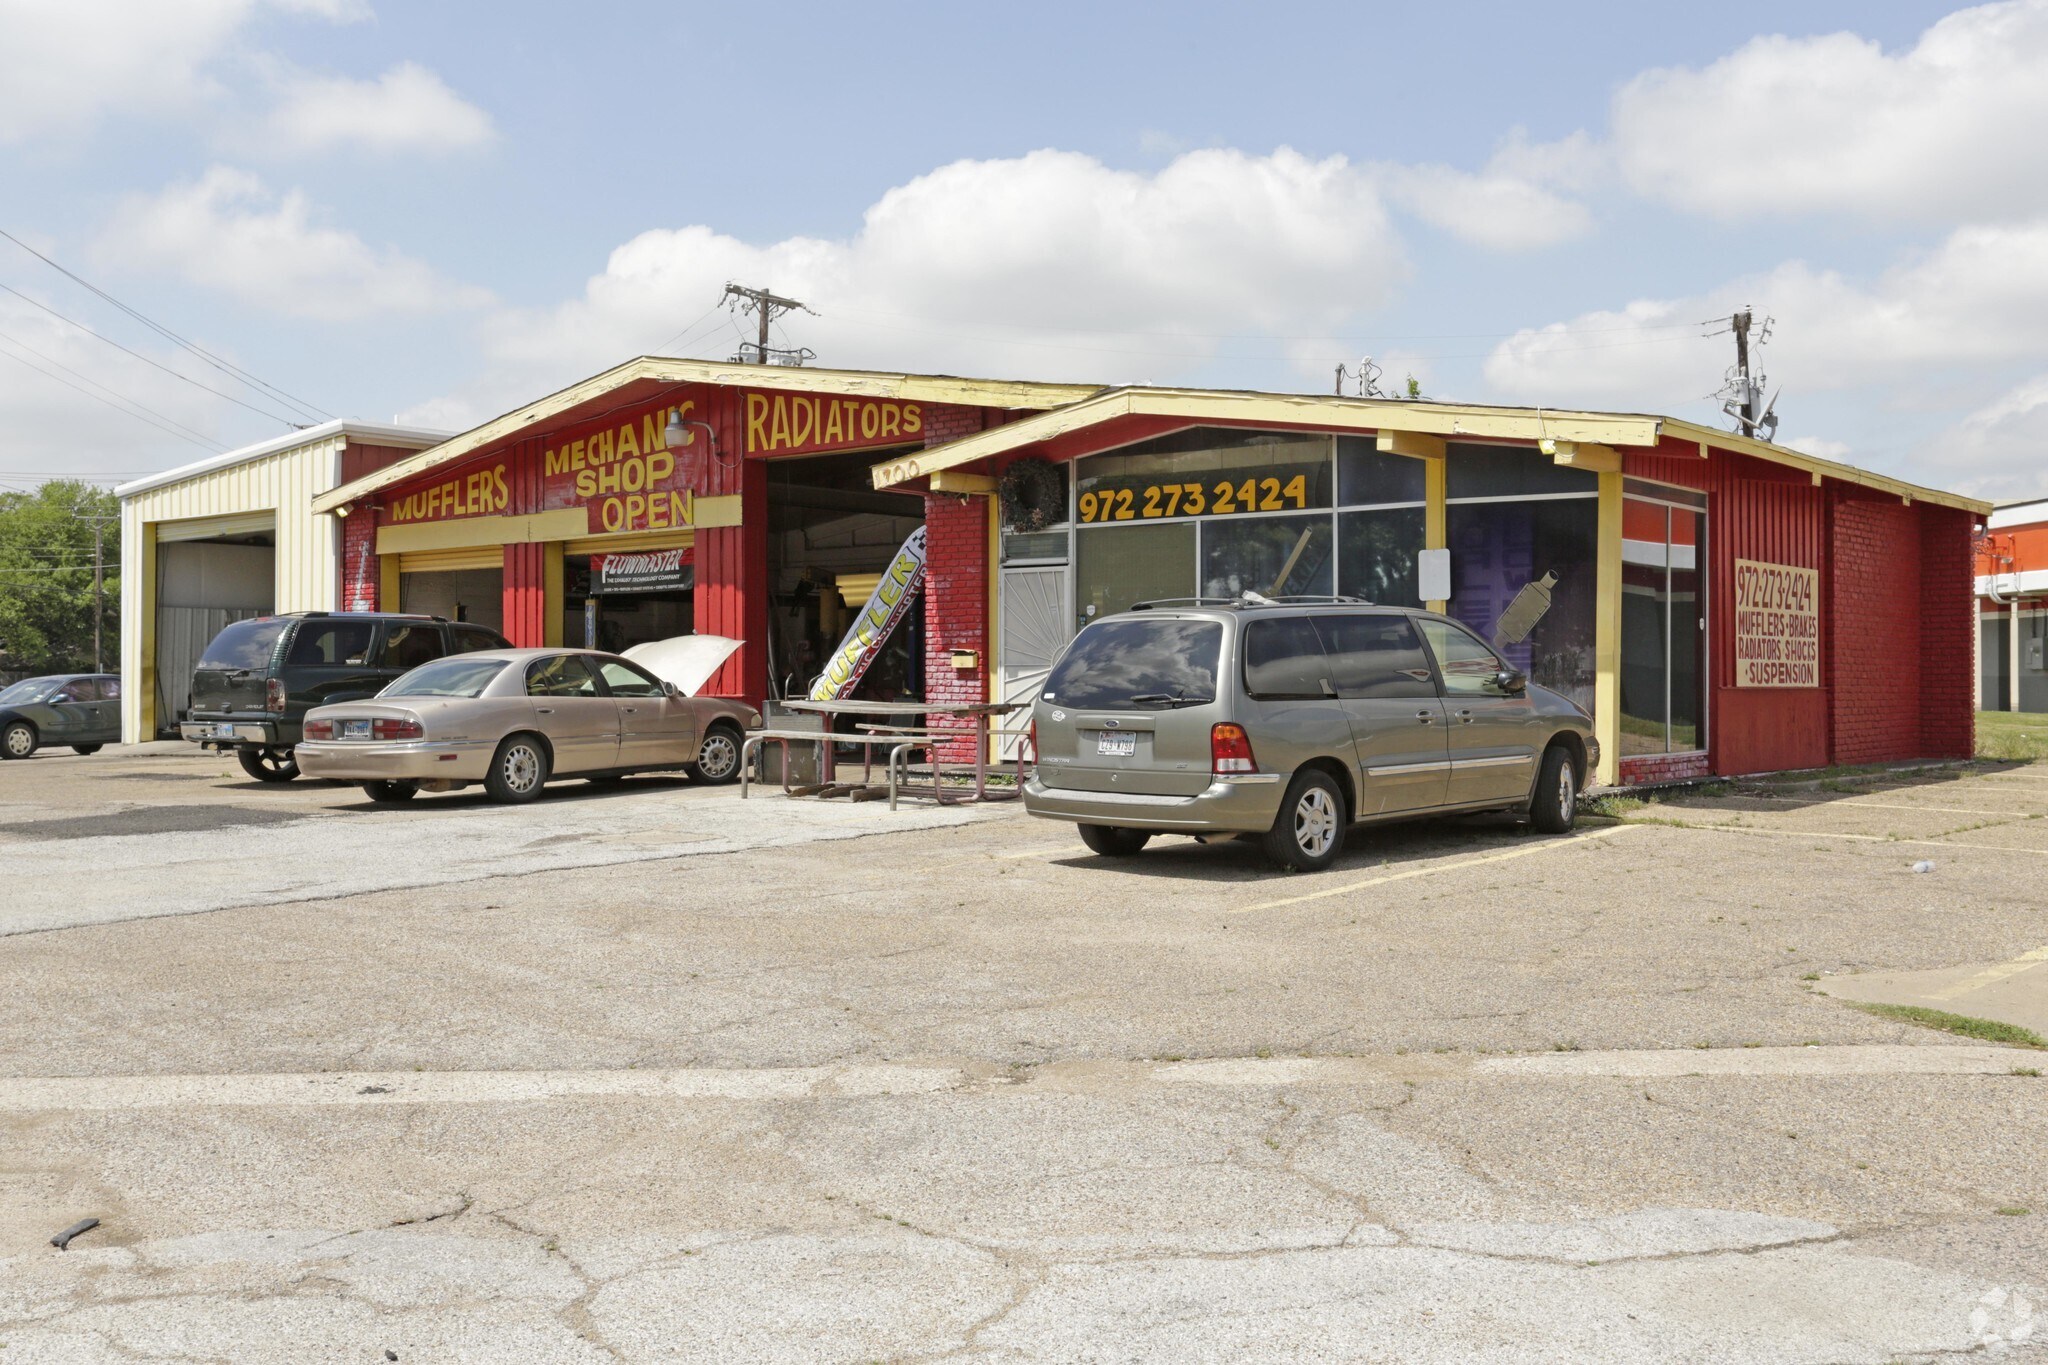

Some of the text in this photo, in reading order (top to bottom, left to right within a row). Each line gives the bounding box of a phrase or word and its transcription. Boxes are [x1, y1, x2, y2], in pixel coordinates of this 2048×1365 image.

[747, 394, 921, 452] RADIATORS
[392, 464, 509, 521] MUFFLERS
[576, 451, 675, 498] SHOP
[1079, 474, 1306, 523] 972 273 2424
[602, 488, 694, 532] OPEN
[602, 548, 684, 584] FLOWMASTER
[814, 553, 917, 700] MUFFLER
[1738, 637, 1816, 662] RADIATORS SHOCKS
